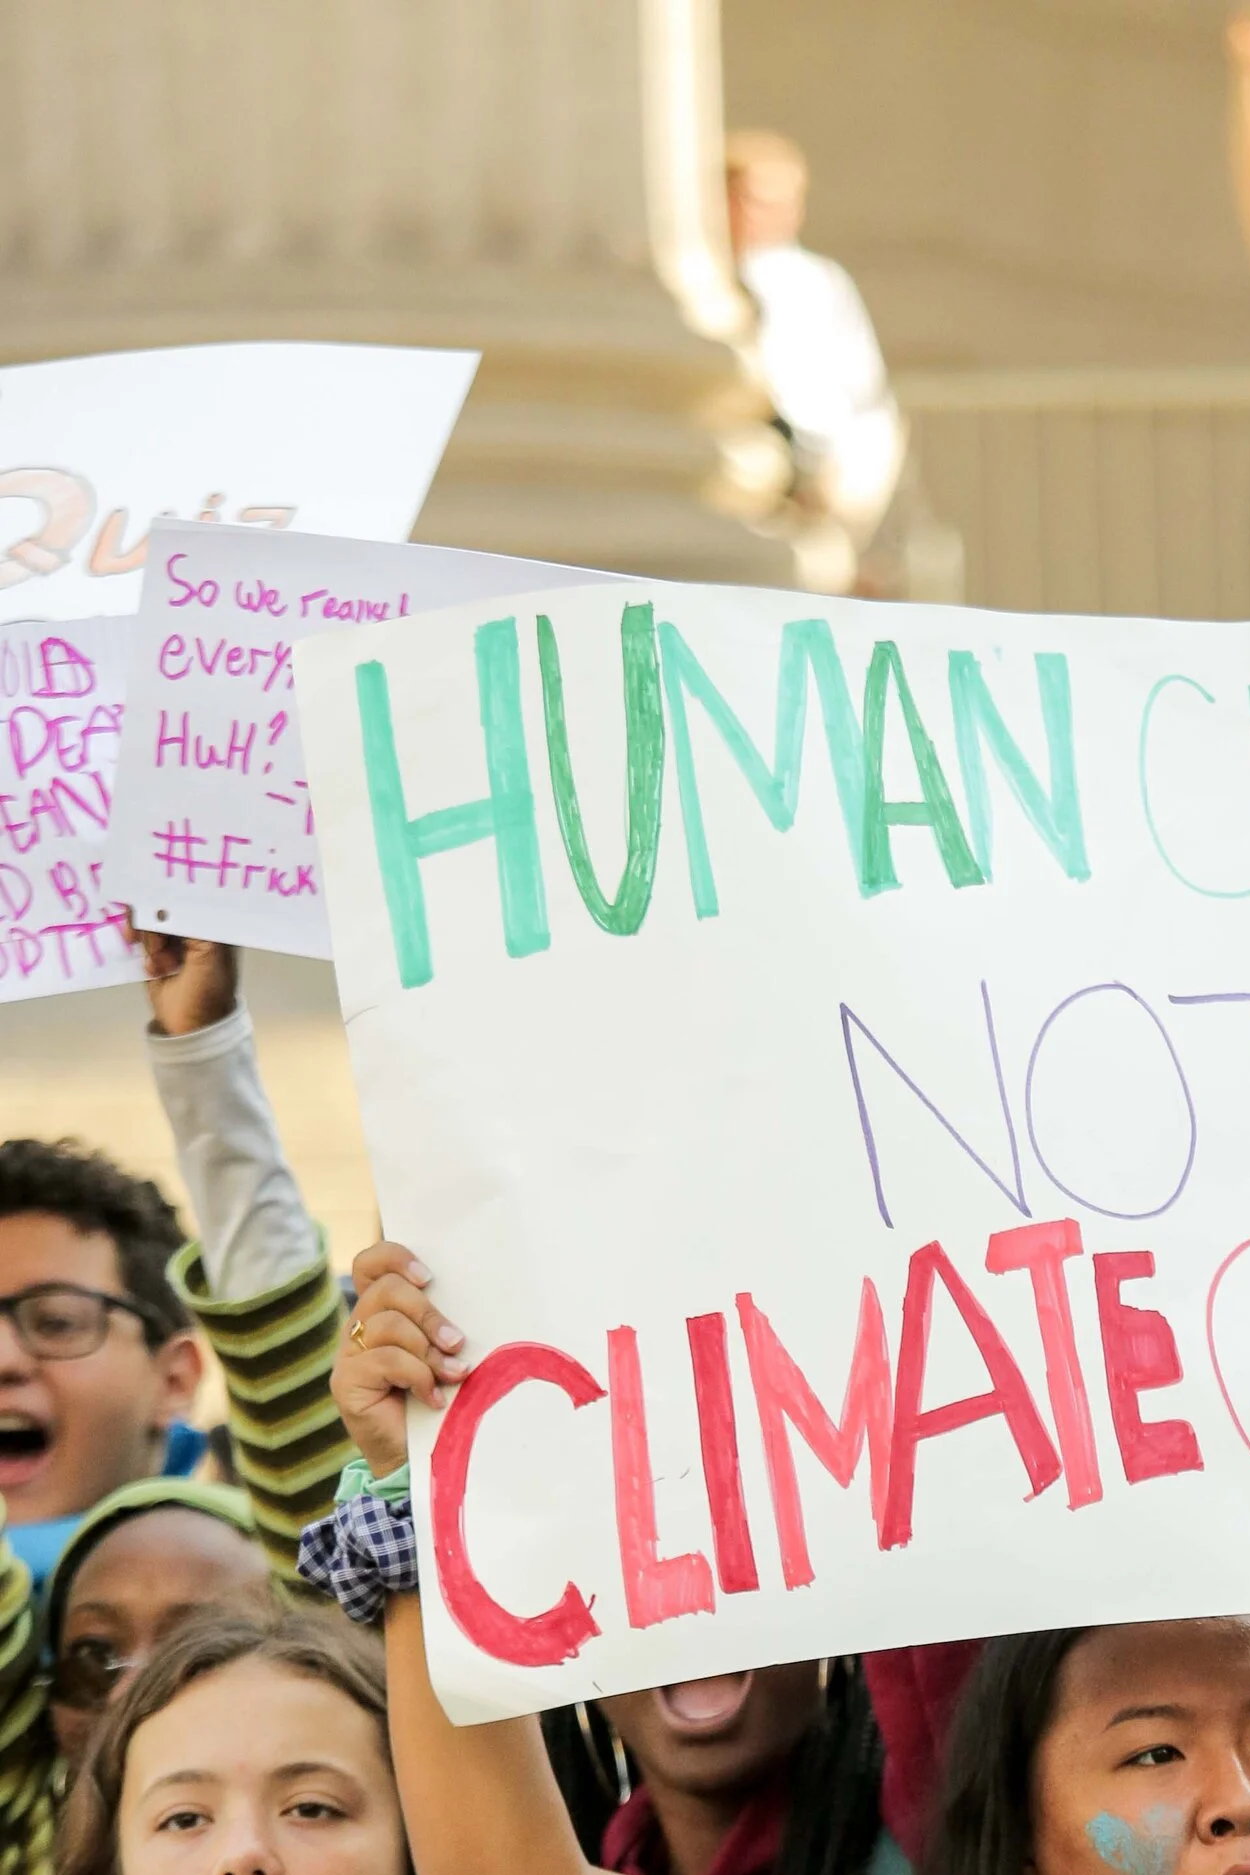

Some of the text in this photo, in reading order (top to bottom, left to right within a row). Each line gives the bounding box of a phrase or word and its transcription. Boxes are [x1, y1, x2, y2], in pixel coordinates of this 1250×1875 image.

[166, 552, 220, 607] So
[356, 601, 1091, 990] HUMAN
[431, 1216, 1205, 1668] CLIMATE
